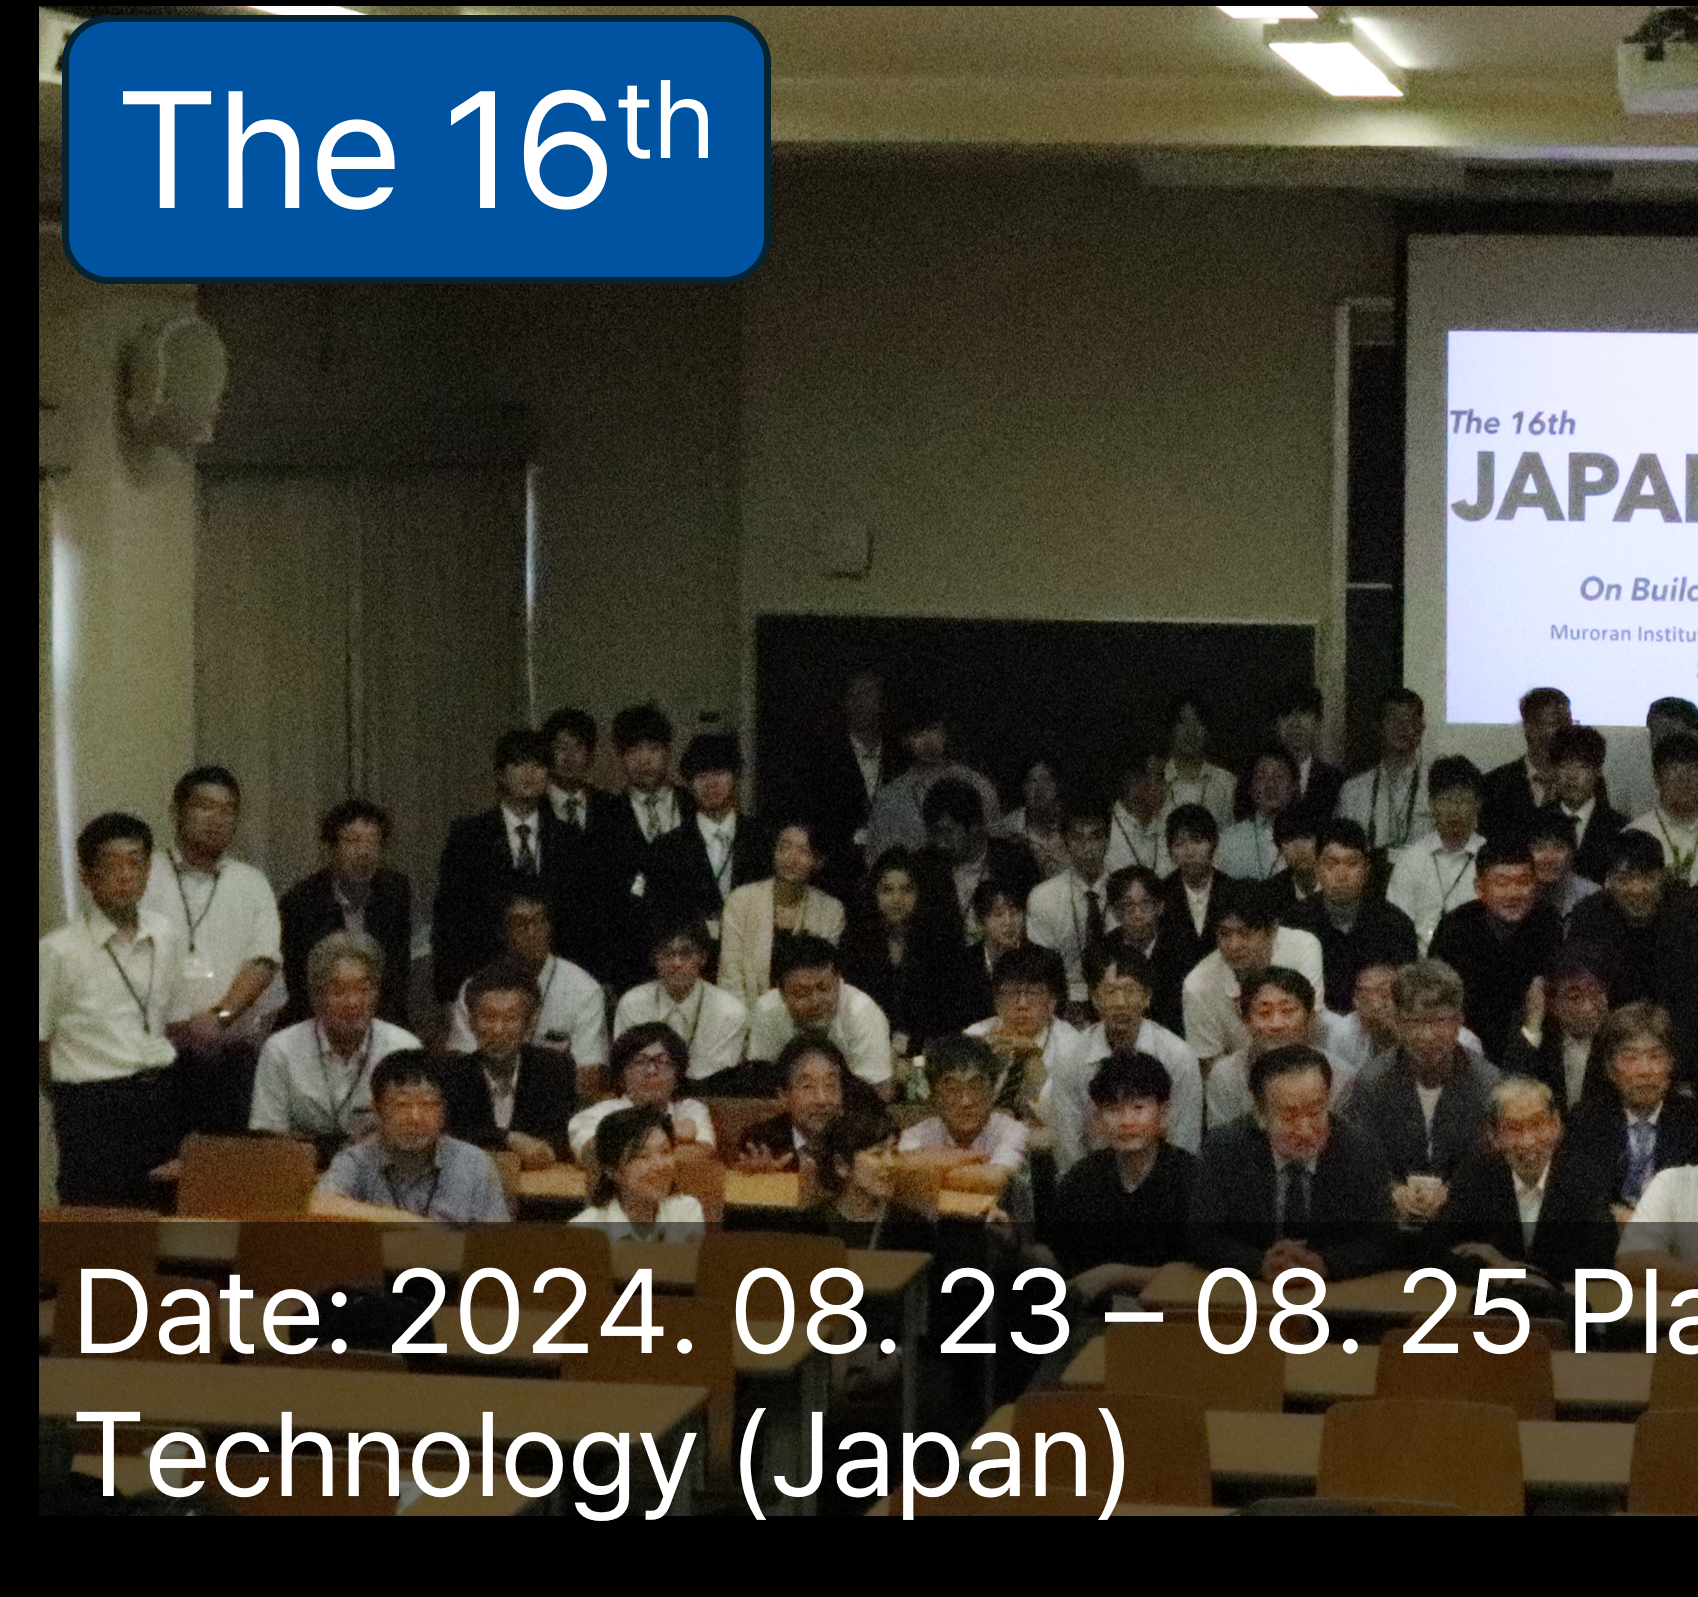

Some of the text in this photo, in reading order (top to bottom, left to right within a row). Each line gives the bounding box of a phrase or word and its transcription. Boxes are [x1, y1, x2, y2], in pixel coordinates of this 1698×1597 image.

[1449, 409, 1576, 436] The 16th
[1579, 575, 1622, 601] On
[1550, 624, 1632, 642] Muroran
